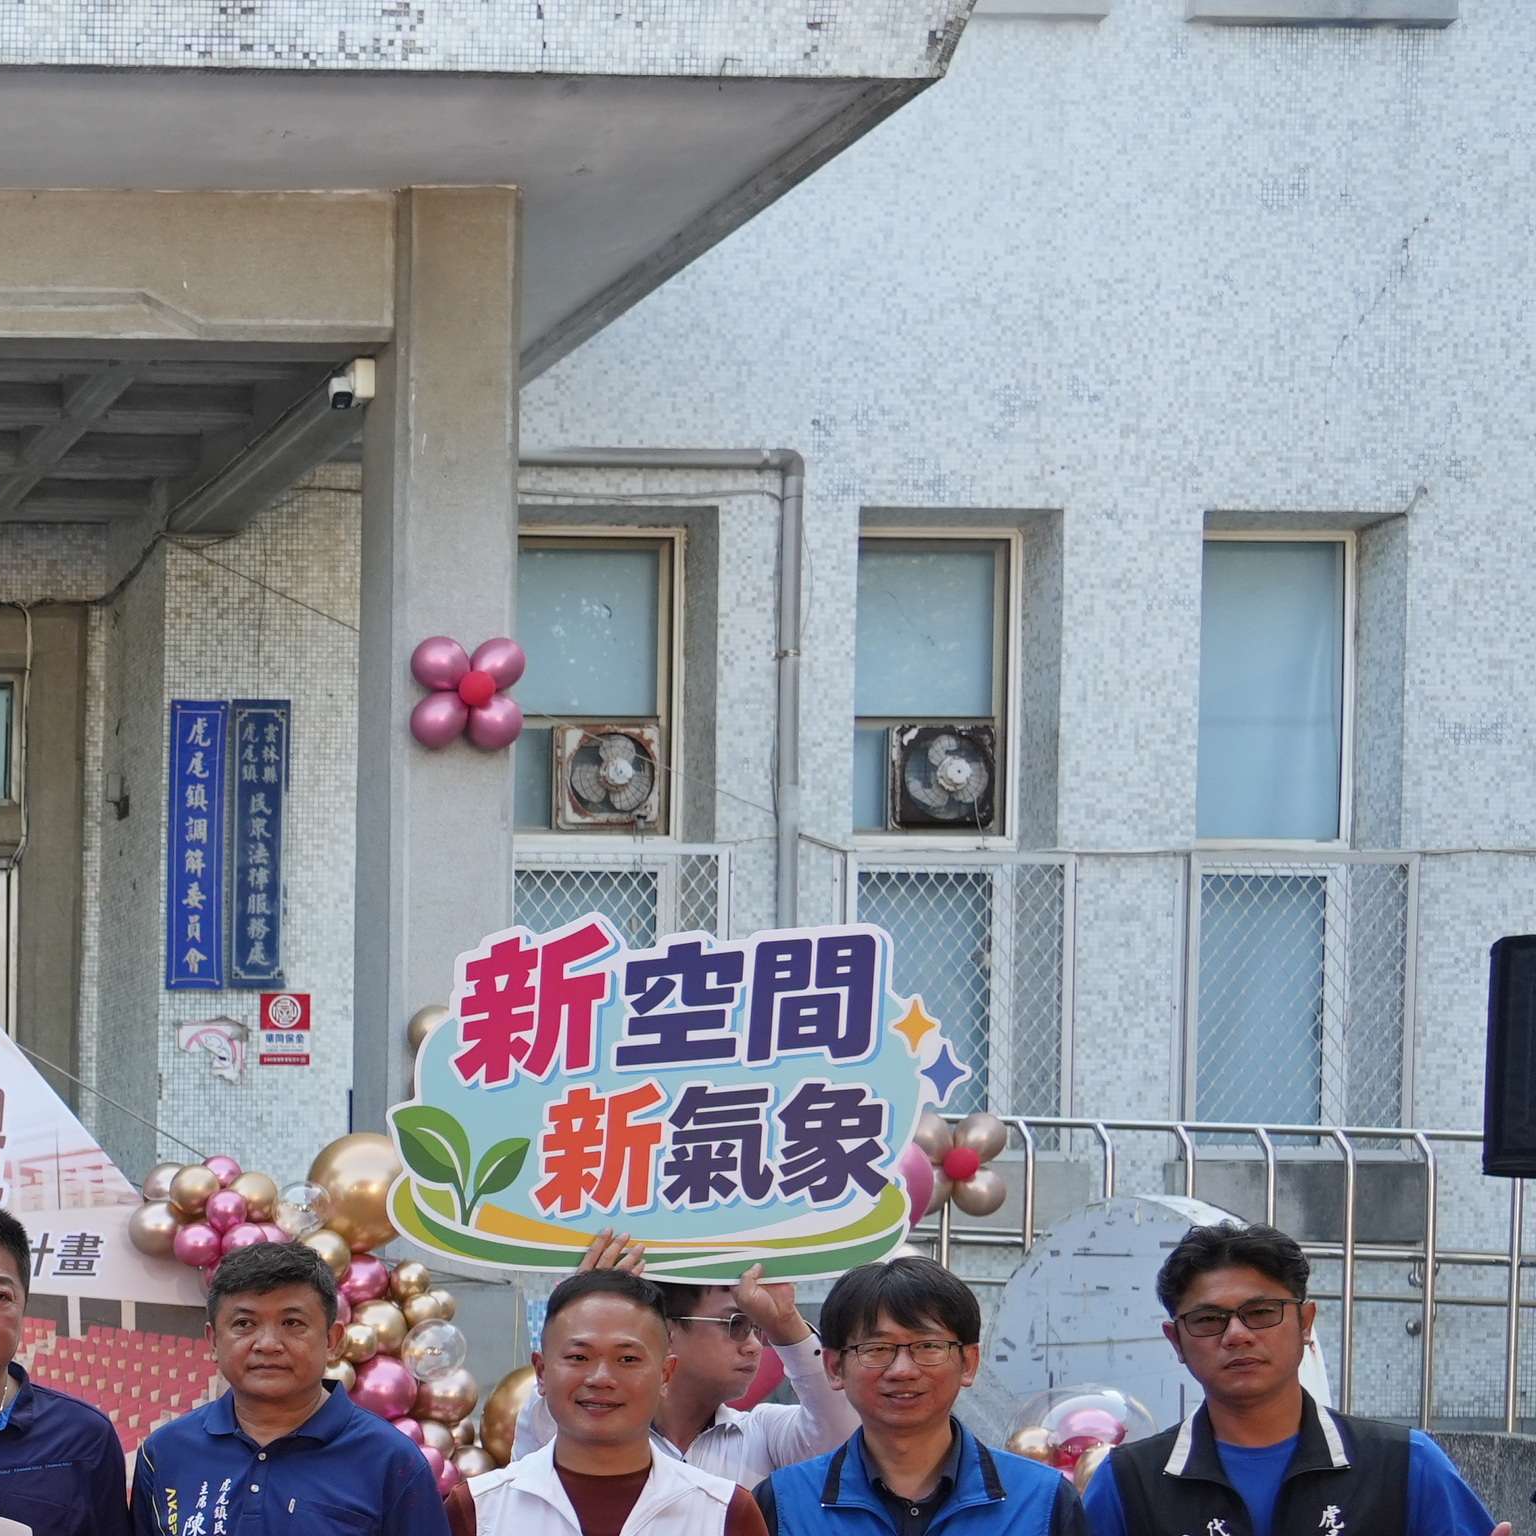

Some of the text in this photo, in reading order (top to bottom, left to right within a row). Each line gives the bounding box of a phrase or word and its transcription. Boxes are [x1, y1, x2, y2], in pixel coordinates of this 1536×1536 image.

[241, 722, 259, 785] 虎尾鎮
[262, 723, 280, 785] 雲林縣
[182, 717, 212, 975] 虎尾鎮調解委員會
[454, 922, 877, 1085] 新空間
[534, 1082, 891, 1215] 新氣象
[195, 1481, 208, 1510] 主席
